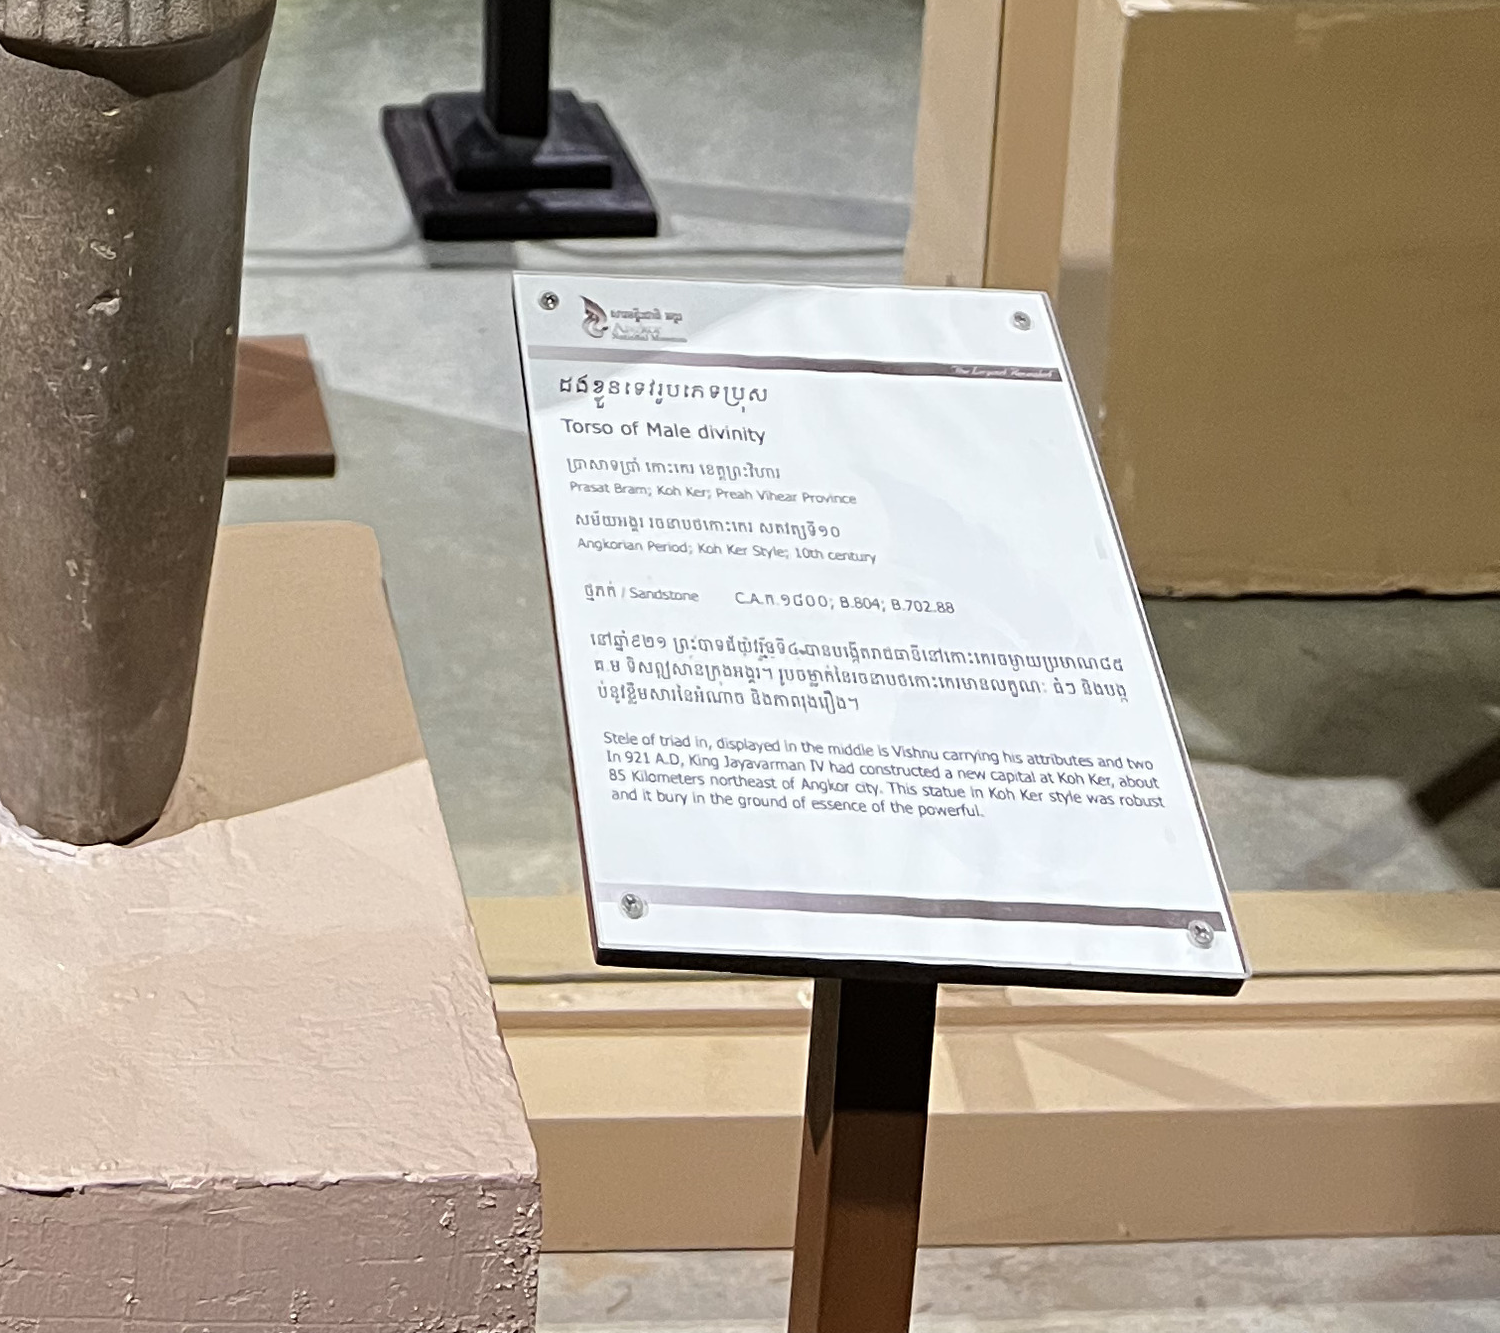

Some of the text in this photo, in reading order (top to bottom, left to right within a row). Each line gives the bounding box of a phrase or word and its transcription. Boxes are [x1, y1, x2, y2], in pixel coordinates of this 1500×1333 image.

[561, 418, 765, 445] Torso of Male divinity
[570, 481, 857, 505] Prasat Bram; Koh Ker; Preah Vihear Province
[578, 538, 876, 565] Angkorian Period; Koh Ker Style; 10th century
[629, 587, 699, 602] Sandstone
[891, 598, 955, 614] B.702.88
[604, 732, 1153, 771] Stele of triad in, displayed in the middle is Vishnu carrying his attributes and two
[606, 750, 620, 763] In
[625, 751, 650, 764] 921
[689, 754, 719, 769] King
[724, 756, 806, 772] Jayavarman
[810, 759, 824, 772] IV
[830, 761, 854, 775] had
[859, 763, 940, 779] constructed
[945, 769, 952, 779] a
[958, 769, 986, 781] new
[991, 769, 1036, 784] capital
[1040, 772, 1054, 784] at
[1058, 772, 1084, 785] Koh
[1088, 775, 1114, 788] Ker,
[1120, 776, 1159, 789] about
[609, 769, 1165, 807] 85 Kilometers northeast of Angkor city. This statue in Koh Ker style was robust
[612, 789, 984, 817] and it bury in the ground of essence of the powerful.
